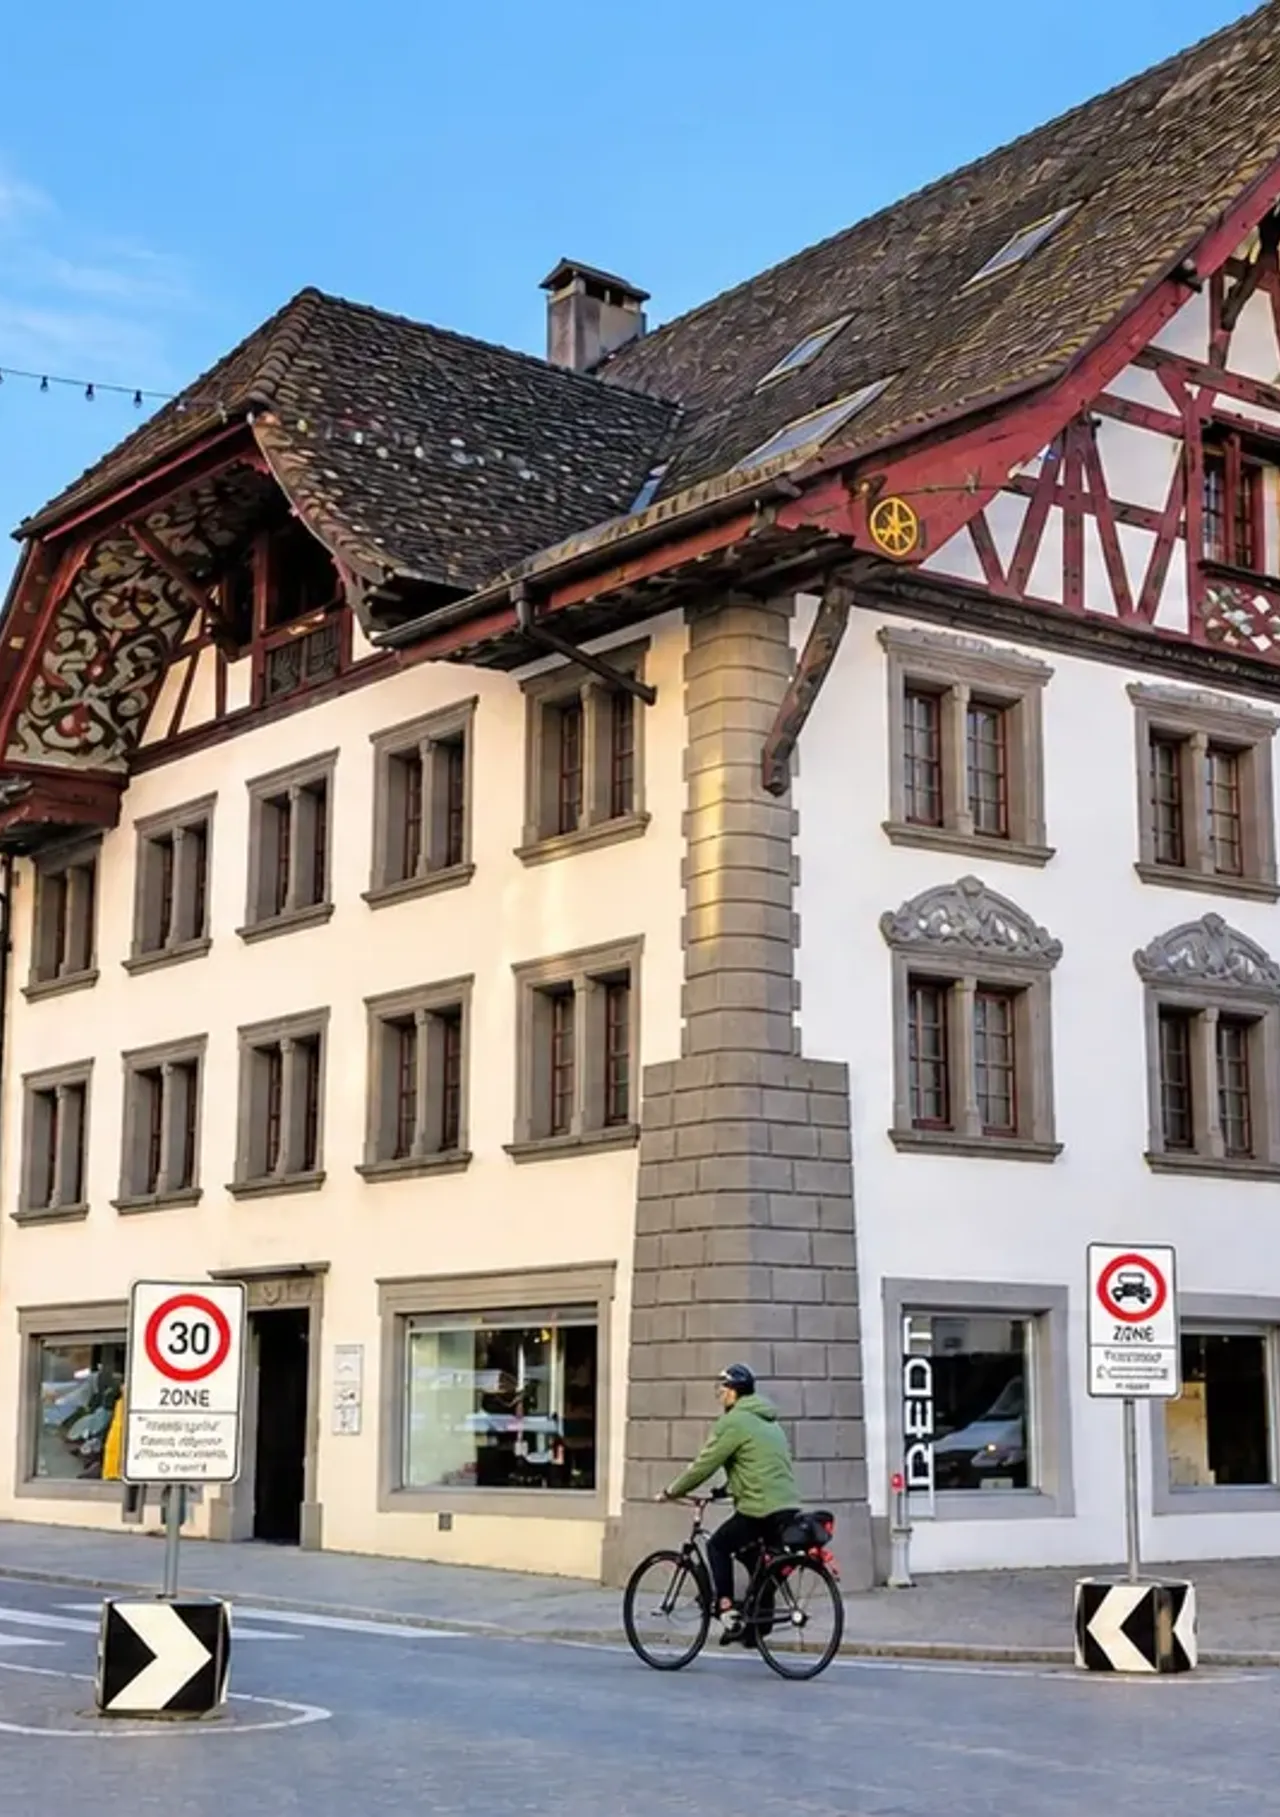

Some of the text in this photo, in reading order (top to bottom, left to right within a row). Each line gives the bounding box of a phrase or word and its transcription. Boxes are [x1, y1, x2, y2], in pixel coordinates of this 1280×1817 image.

[168, 1321, 210, 1355] 30
[1113, 1326, 1154, 1342] ZONE
[159, 1388, 210, 1407] ZONE
